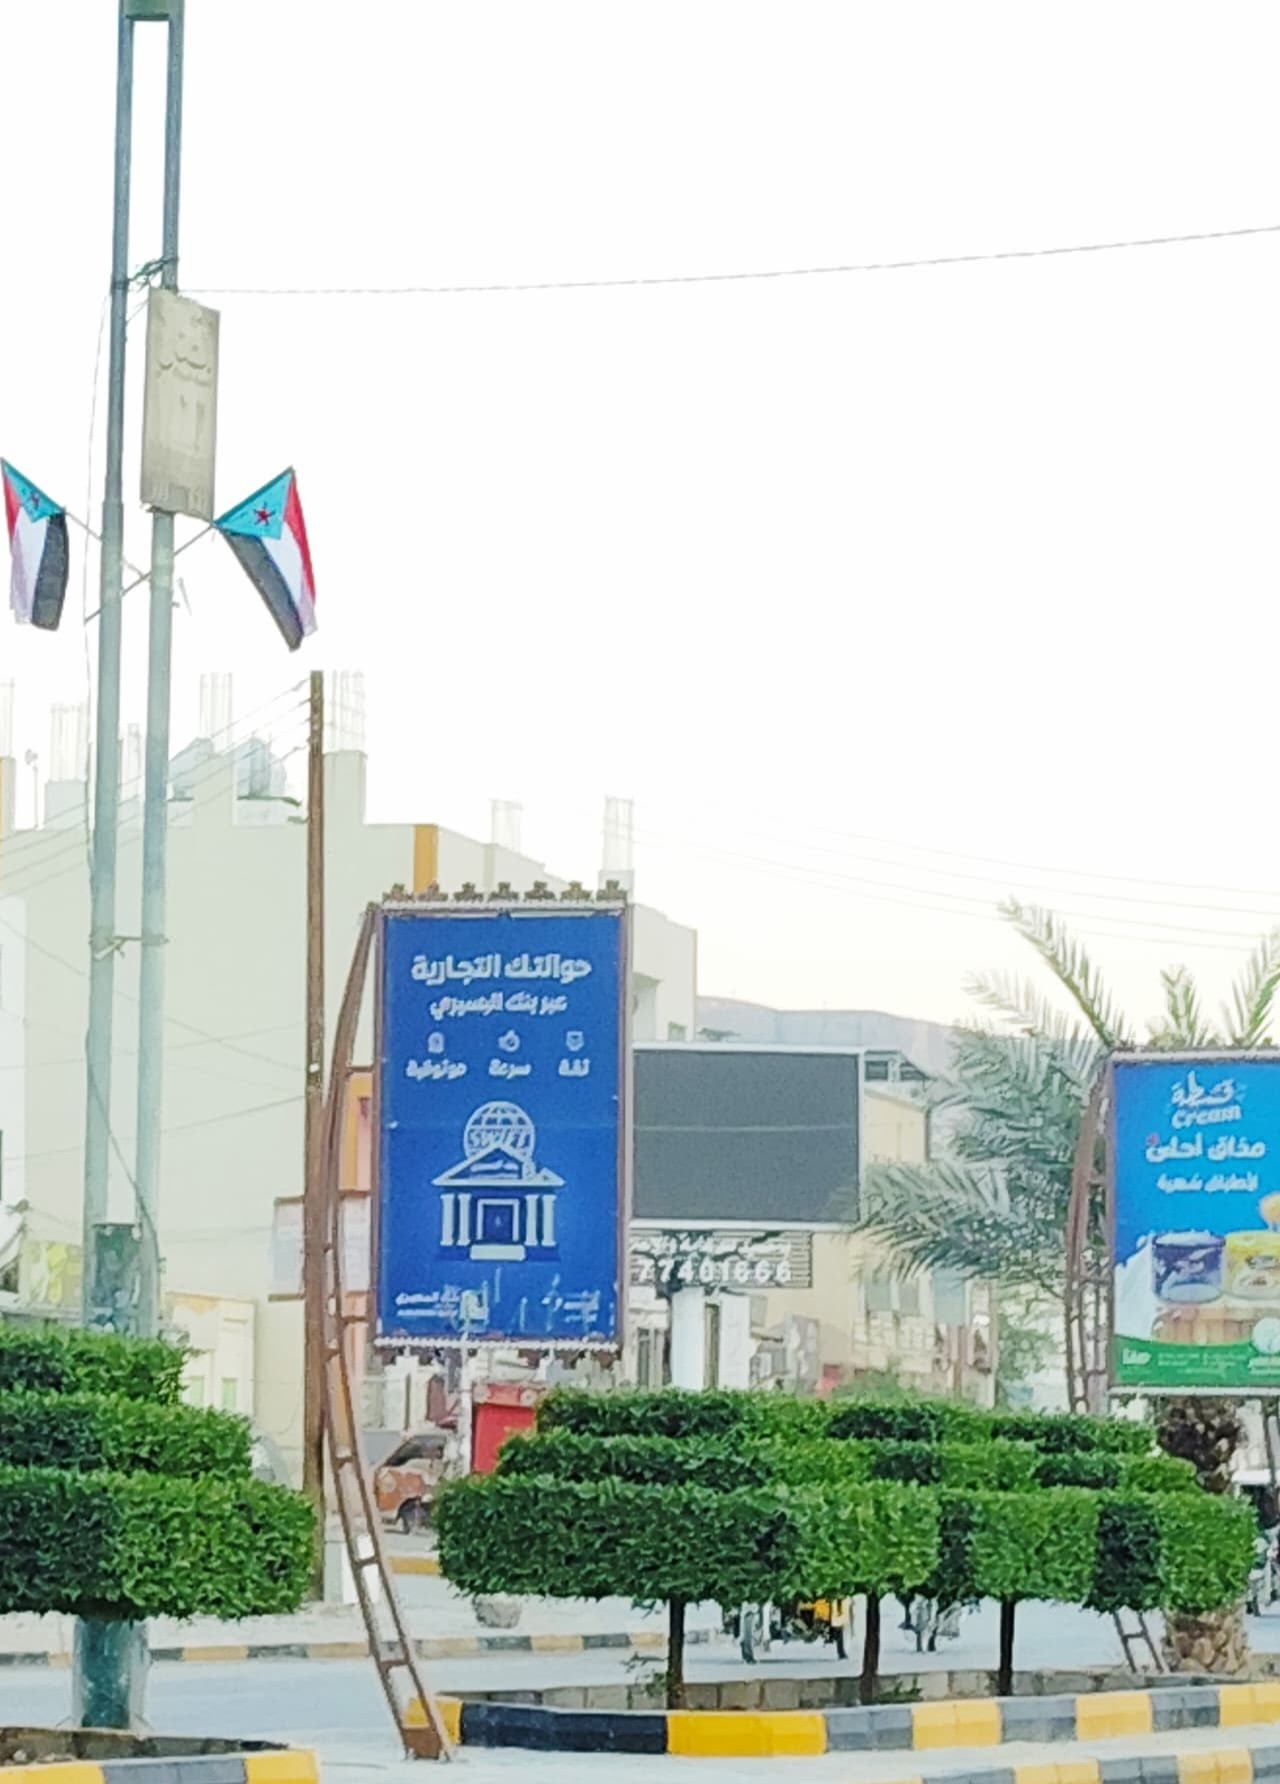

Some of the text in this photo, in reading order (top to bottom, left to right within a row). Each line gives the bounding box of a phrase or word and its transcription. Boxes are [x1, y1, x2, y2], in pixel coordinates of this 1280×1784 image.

[411, 953, 592, 986] حوالتك التجارية
[505, 990, 539, 1016] بنك
[539, 995, 568, 1016] عبر
[488, 1057, 532, 1080] سرعة
[1171, 1104, 1242, 1130] Cream
[1207, 1135, 1266, 1161] مذاق
